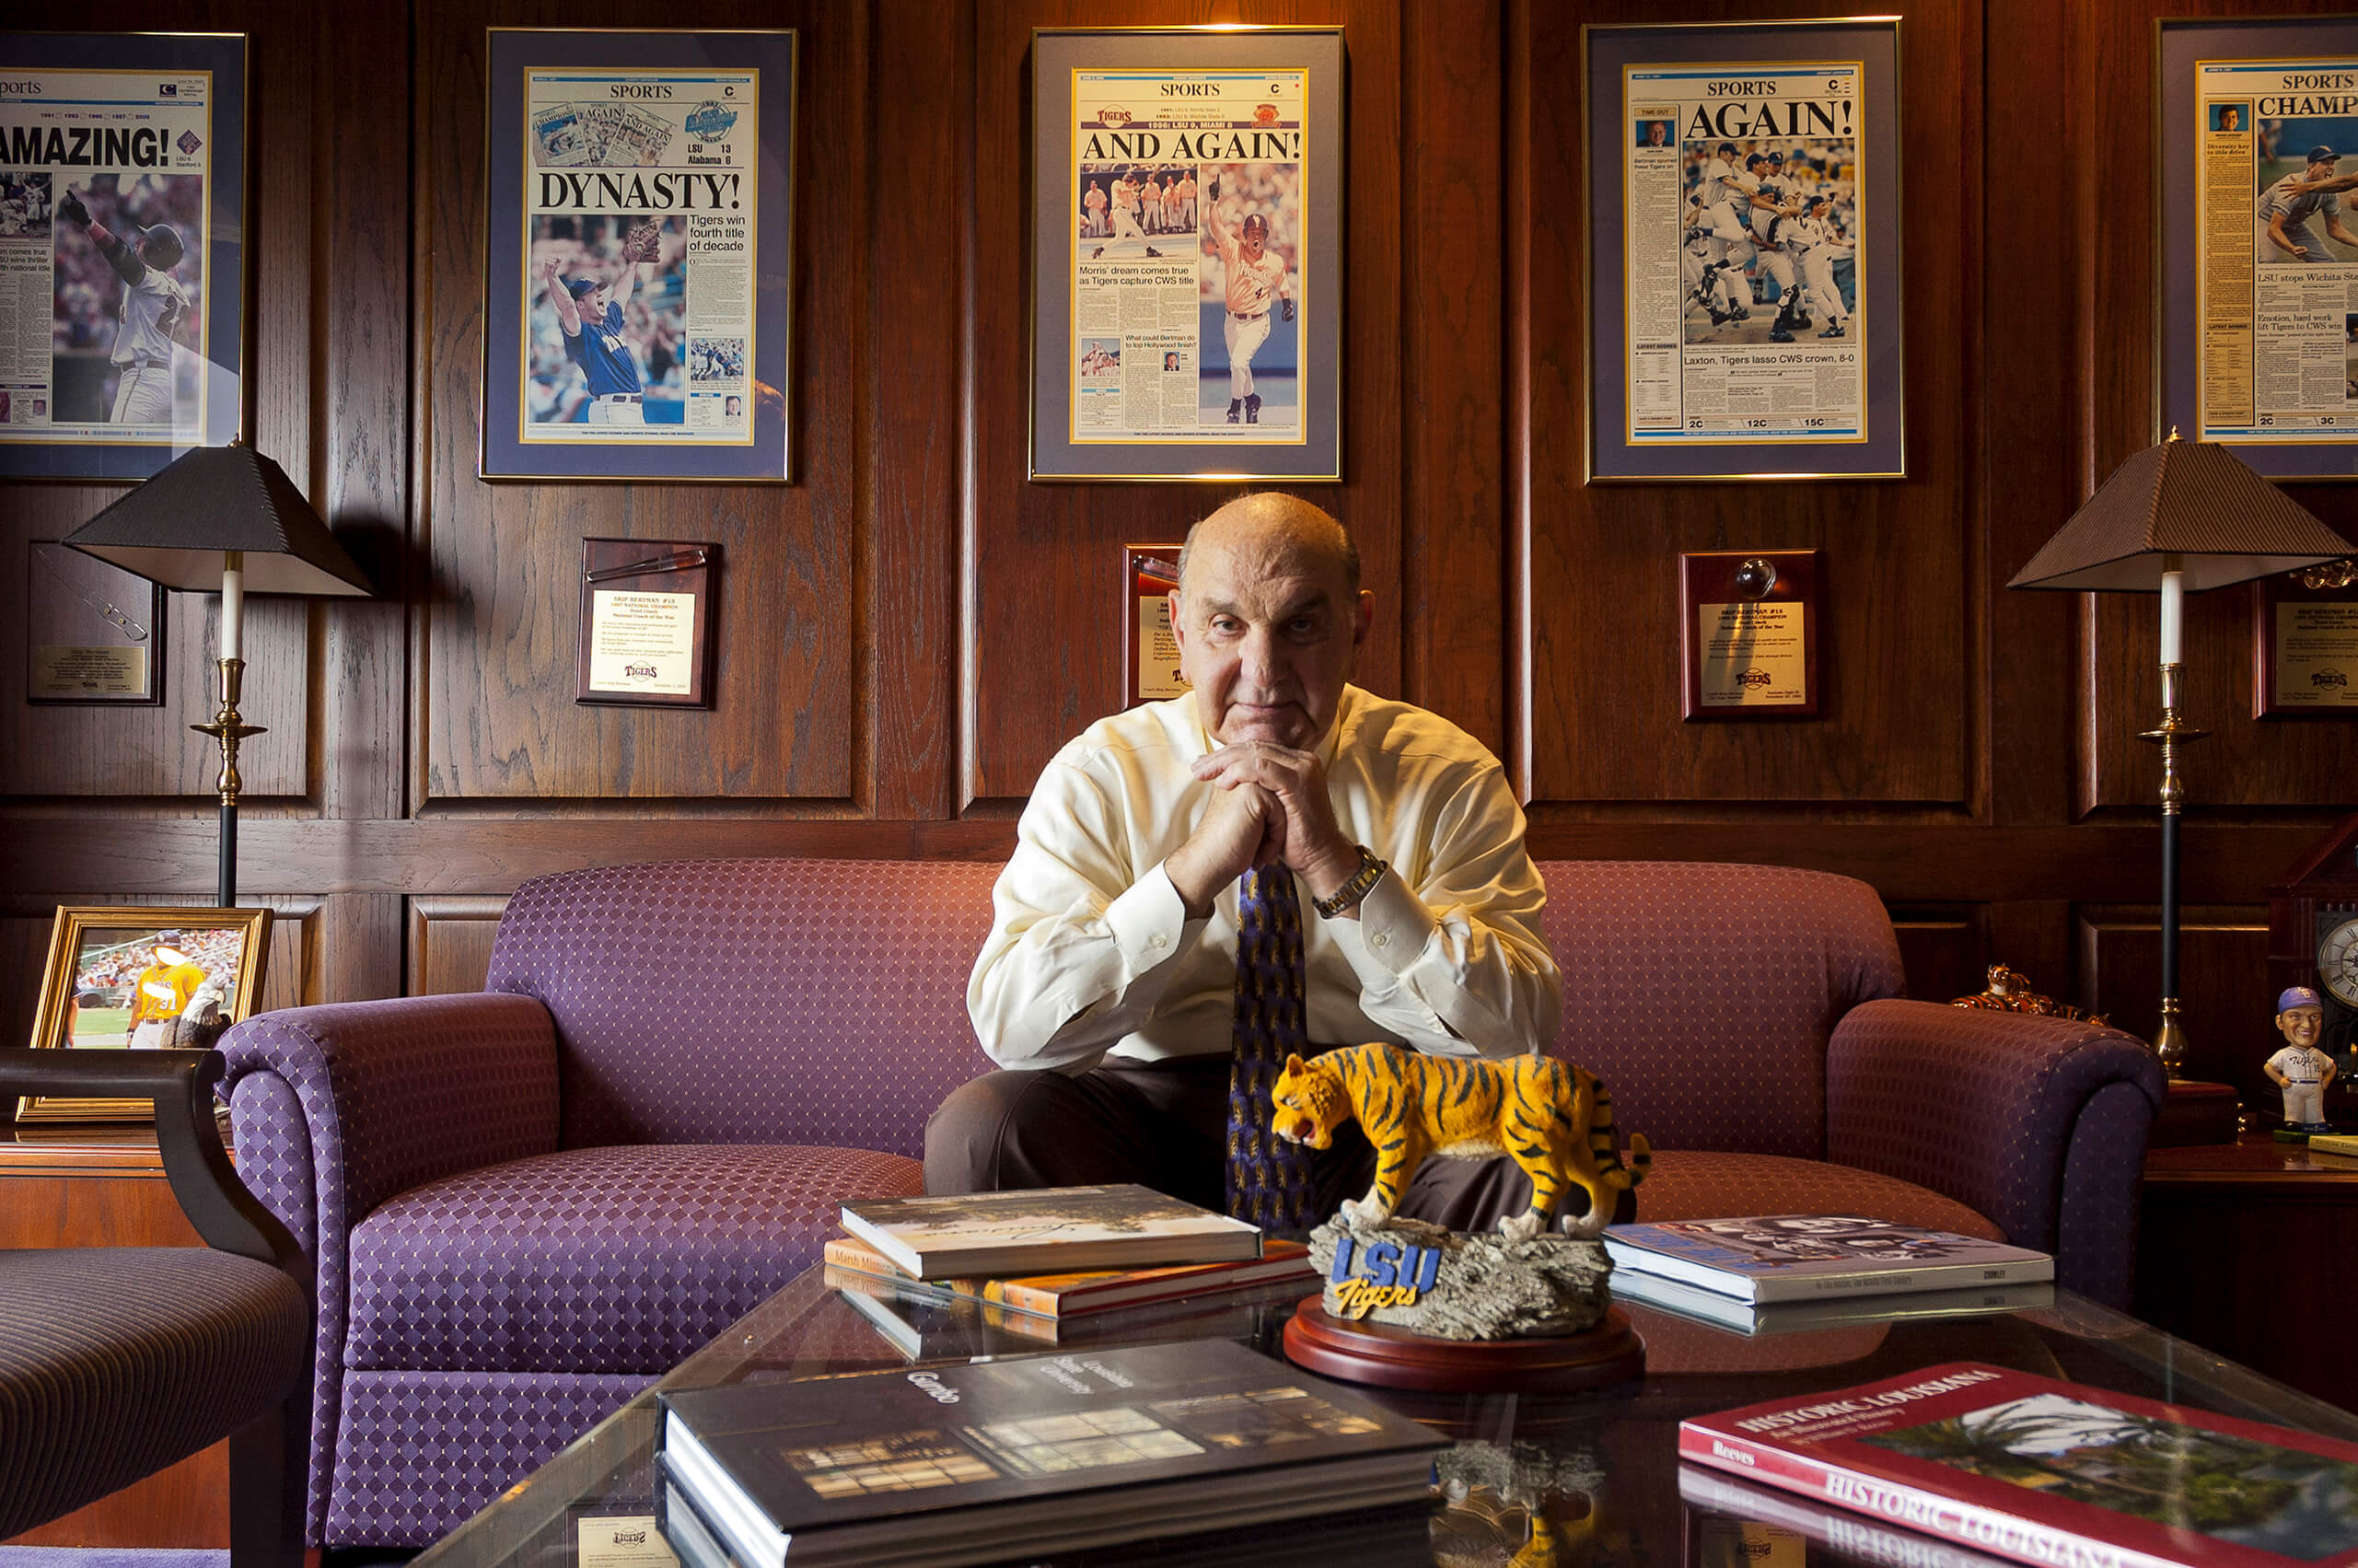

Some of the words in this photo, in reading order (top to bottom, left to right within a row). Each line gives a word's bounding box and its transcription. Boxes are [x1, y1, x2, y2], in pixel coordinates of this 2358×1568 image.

[1829, 79, 1839, 90] C
[2282, 75, 2354, 89] SPORTS
[610, 85, 672, 99] SPORTS
[725, 86, 734, 97] C
[1160, 83, 1220, 97] SPORTS
[1271, 84, 1280, 94] C
[1707, 80, 1776, 97] SPORTS
[2259, 96, 2358, 116] CHAMP
[1098, 110, 1132, 122] TIGERS
[1685, 100, 1853, 139] AGAIN!
[0, 126, 168, 168] AMAZING!
[688, 144, 703, 153] LSU
[721, 144, 731, 154] 13
[1083, 133, 1160, 159] AND
[1171, 132, 1300, 160] AGAIN!
[688, 155, 722, 165] Alabama
[539, 172, 740, 210] DYNASTY!
[690, 214, 724, 226] Tigers
[726, 215, 746, 226] win
[690, 227, 723, 238] fourth
[725, 227, 745, 238] title
[690, 240, 701, 251] of
[703, 240, 744, 251] decade
[1110, 266, 1139, 275] dream
[1171, 266, 1189, 275] true
[1092, 276, 1119, 287] Tigers
[1120, 277, 1153, 287] capture
[1155, 276, 1178, 285] CWS
[1179, 276, 1195, 285] title
[2281, 274, 2304, 284] stops
[2306, 273, 2342, 282] Wichita
[1255, 287, 1263, 299] 4
[2258, 314, 2292, 322] Emotion,
[2313, 313, 2332, 321] work
[2271, 322, 2294, 331] Tigers
[1684, 356, 1718, 366] Laxton,
[1721, 355, 1749, 366] Tigers
[1752, 355, 1777, 364] lasso
[1779, 354, 1803, 364] CWS
[1839, 354, 1854, 363] 8-0
[1690, 420, 1703, 428] 2C
[1748, 419, 1767, 428] 12C
[1805, 418, 1824, 427] 15C
[2259, 417, 2274, 425] 2C
[625, 665, 657, 679] TIGERS
[1736, 672, 1771, 686] TIGERS
[835, 1250, 860, 1268] Marsh
[1331, 1237, 1442, 1295] LSU
[1335, 1277, 1418, 1320] Tigers
[1735, 1400, 1872, 1433] HISTORIC
[1861, 1369, 2004, 1409] LOUISIANA
[1713, 1440, 1755, 1466] Reeves
[1824, 1472, 1958, 1532] HISTORIC
[1957, 1513, 2129, 1568] LOUISIAN
